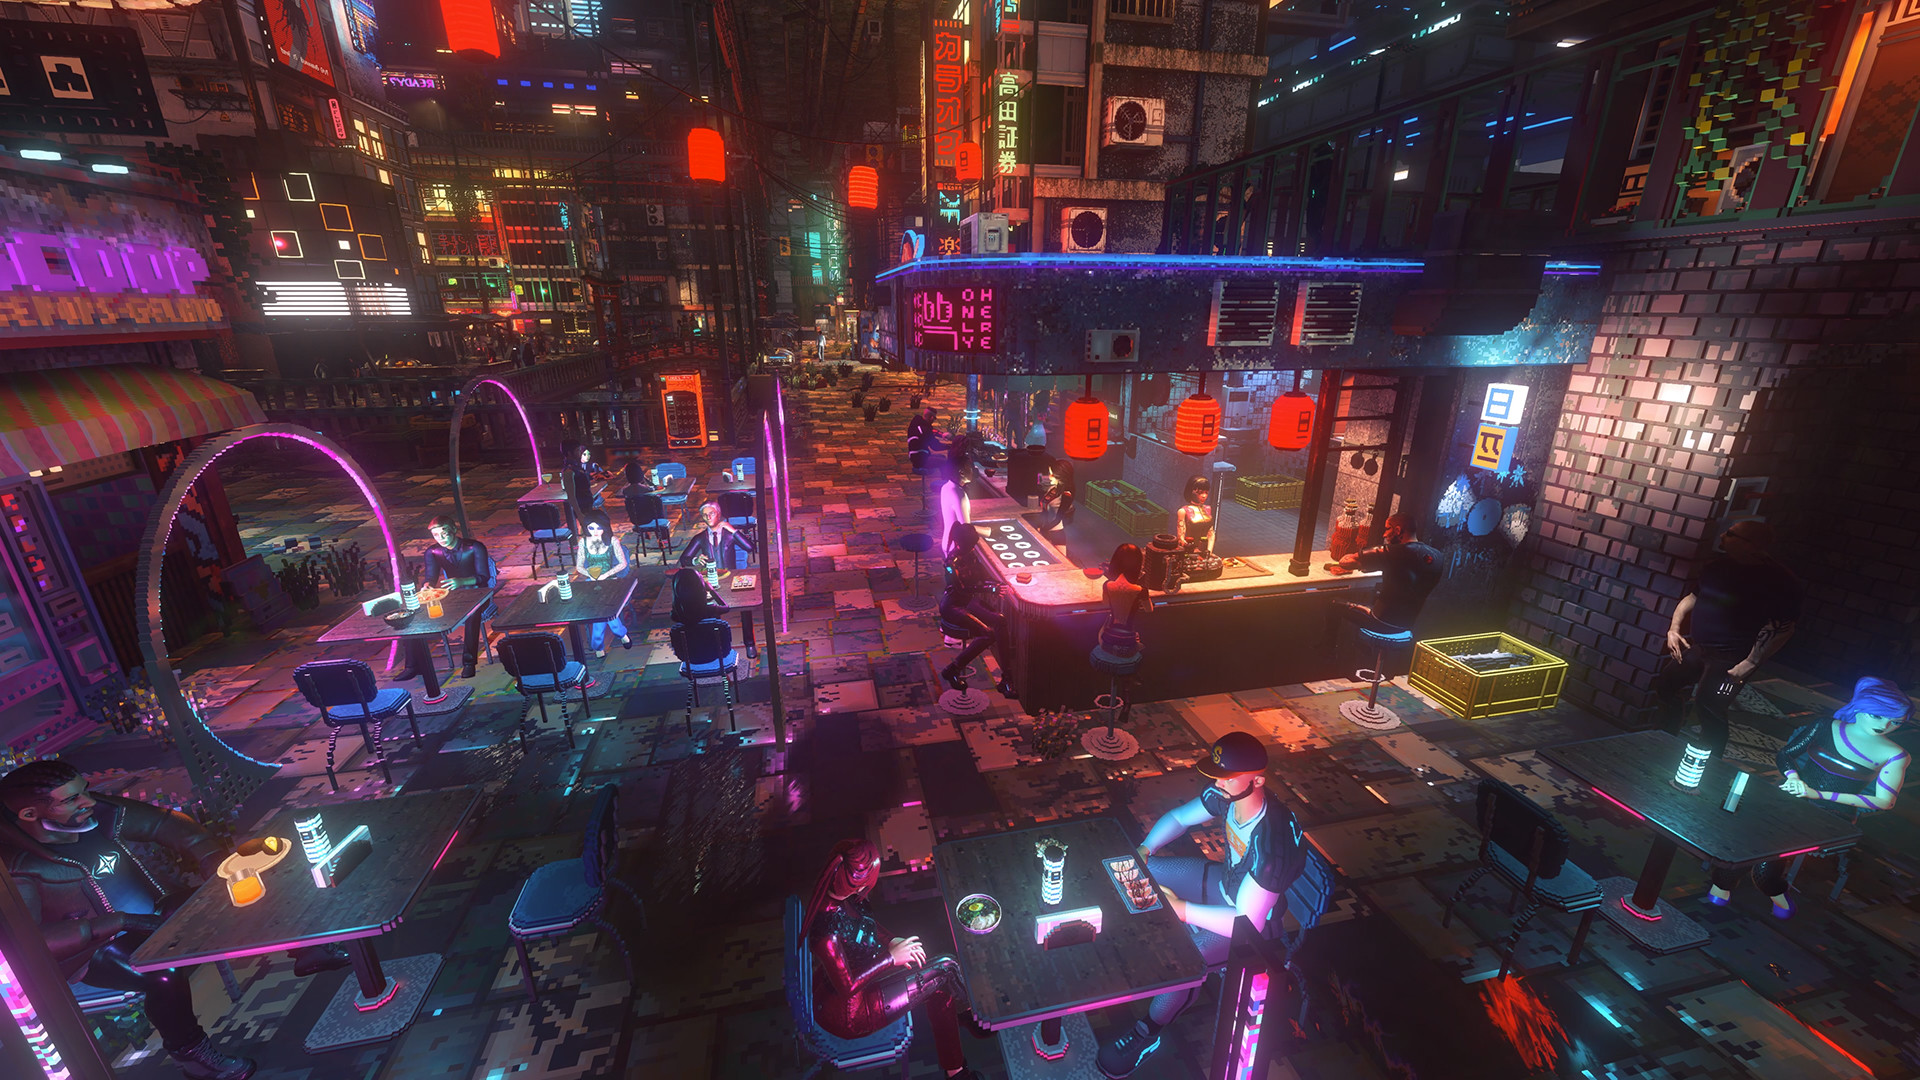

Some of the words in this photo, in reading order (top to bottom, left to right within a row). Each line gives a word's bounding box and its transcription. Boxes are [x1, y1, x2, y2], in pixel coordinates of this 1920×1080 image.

[998, 72, 1018, 174] 高田証券
[0, 231, 211, 294] COOP
